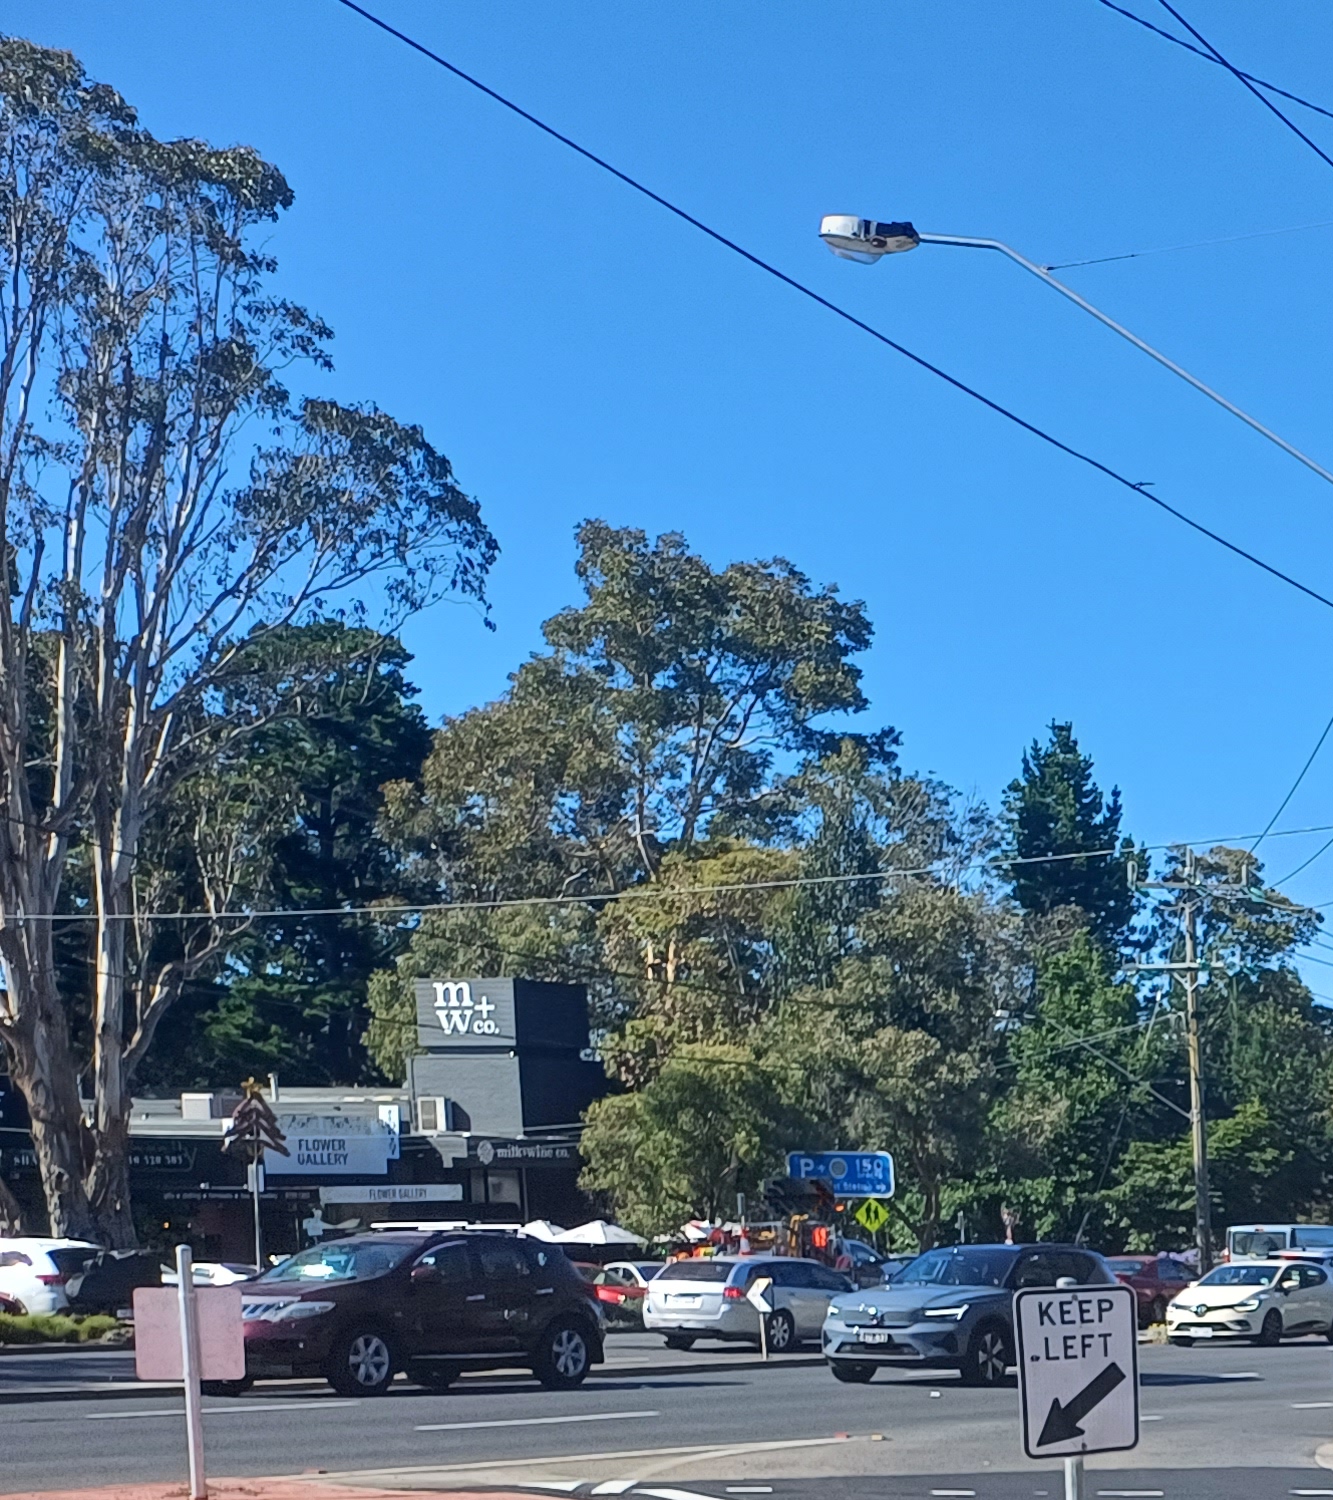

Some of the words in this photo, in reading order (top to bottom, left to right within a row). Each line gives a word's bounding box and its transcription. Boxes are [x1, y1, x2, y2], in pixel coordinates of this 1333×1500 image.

[432, 980, 474, 1007] m
[473, 1019, 500, 1034] co.
[298, 1138, 346, 1151] FLOWER
[297, 1153, 348, 1166] GALLERY
[855, 1158, 884, 1172] 150
[799, 1158, 815, 1179] P
[369, 1188, 397, 1200] FLOWER
[1038, 1298, 1114, 1326] KEEP
[1044, 1333, 1112, 1360] LEFT
